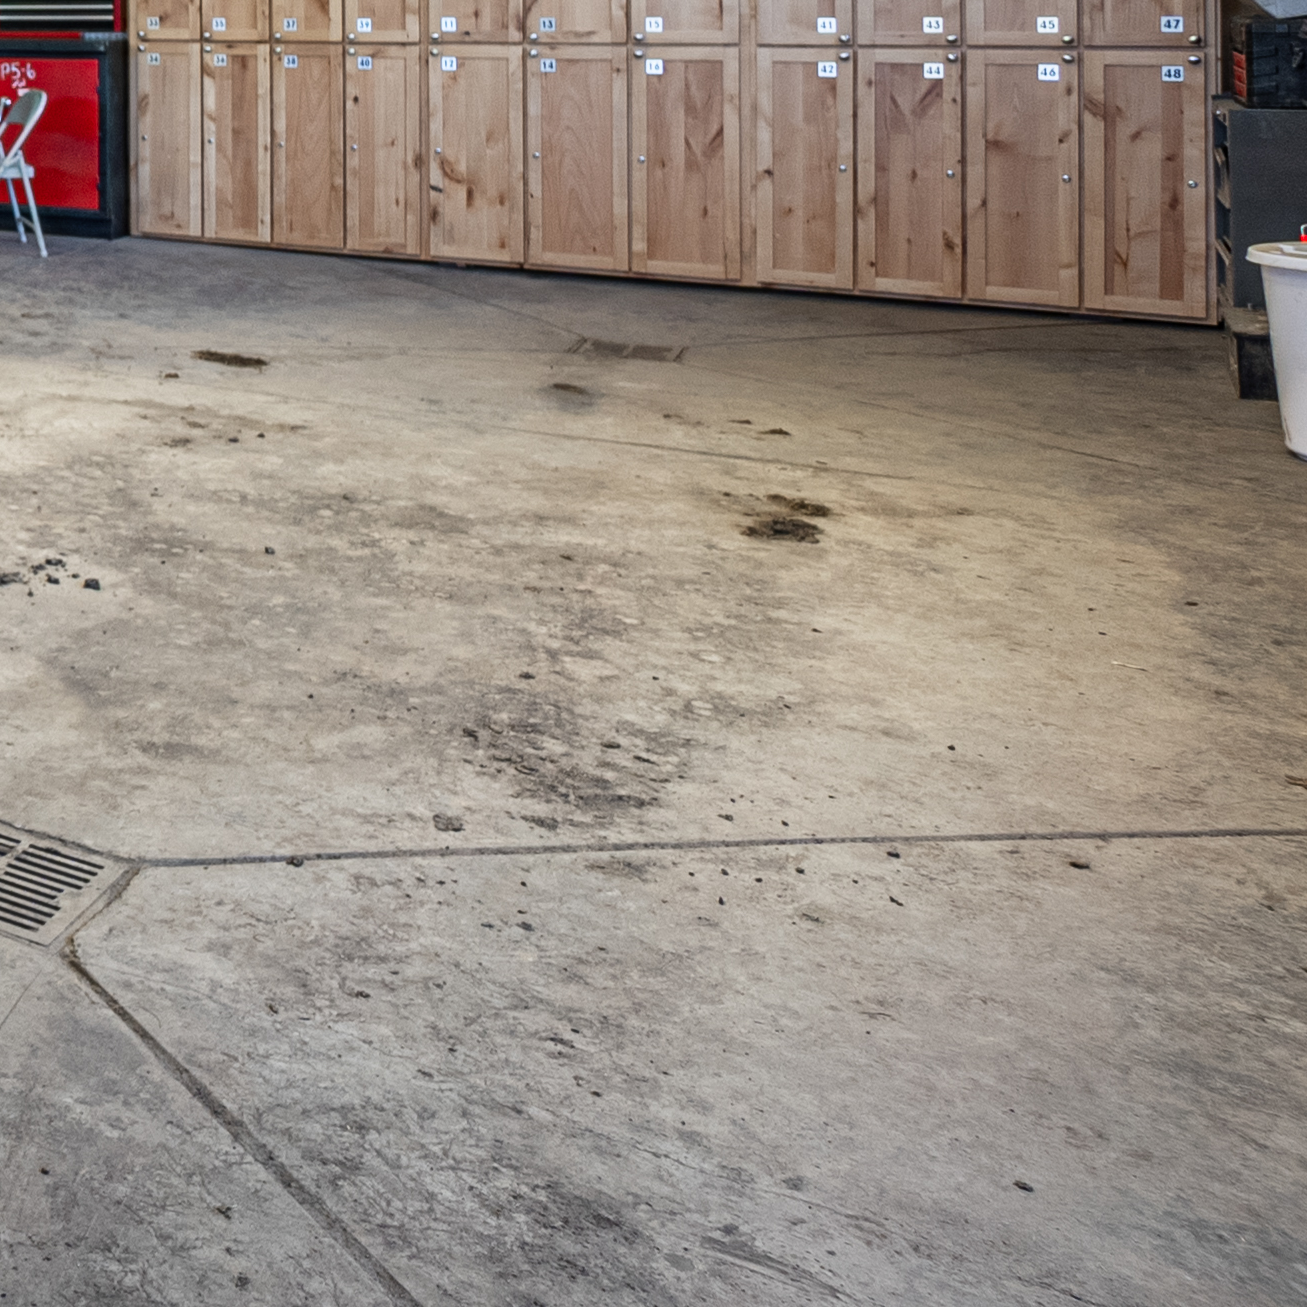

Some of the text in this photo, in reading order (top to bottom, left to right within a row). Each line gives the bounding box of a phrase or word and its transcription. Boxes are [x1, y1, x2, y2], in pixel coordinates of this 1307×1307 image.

[286, 19, 296, 29] 37
[360, 20, 370, 29] 39
[444, 20, 454, 28] 11
[542, 19, 554, 29] 13
[648, 20, 660, 29] 15
[820, 21, 832, 29] 41
[926, 20, 941, 30] 43
[1040, 20, 1056, 29] 45
[1163, 18, 1181, 30] 47
[360, 58, 370, 67] 40
[444, 59, 454, 68] 12
[542, 61, 554, 70] 14
[649, 62, 660, 71] 16
[821, 64, 834, 74] 42
[926, 66, 941, 75] 44
[1040, 67, 1056, 77] 46
[1163, 68, 1182, 79] 48
